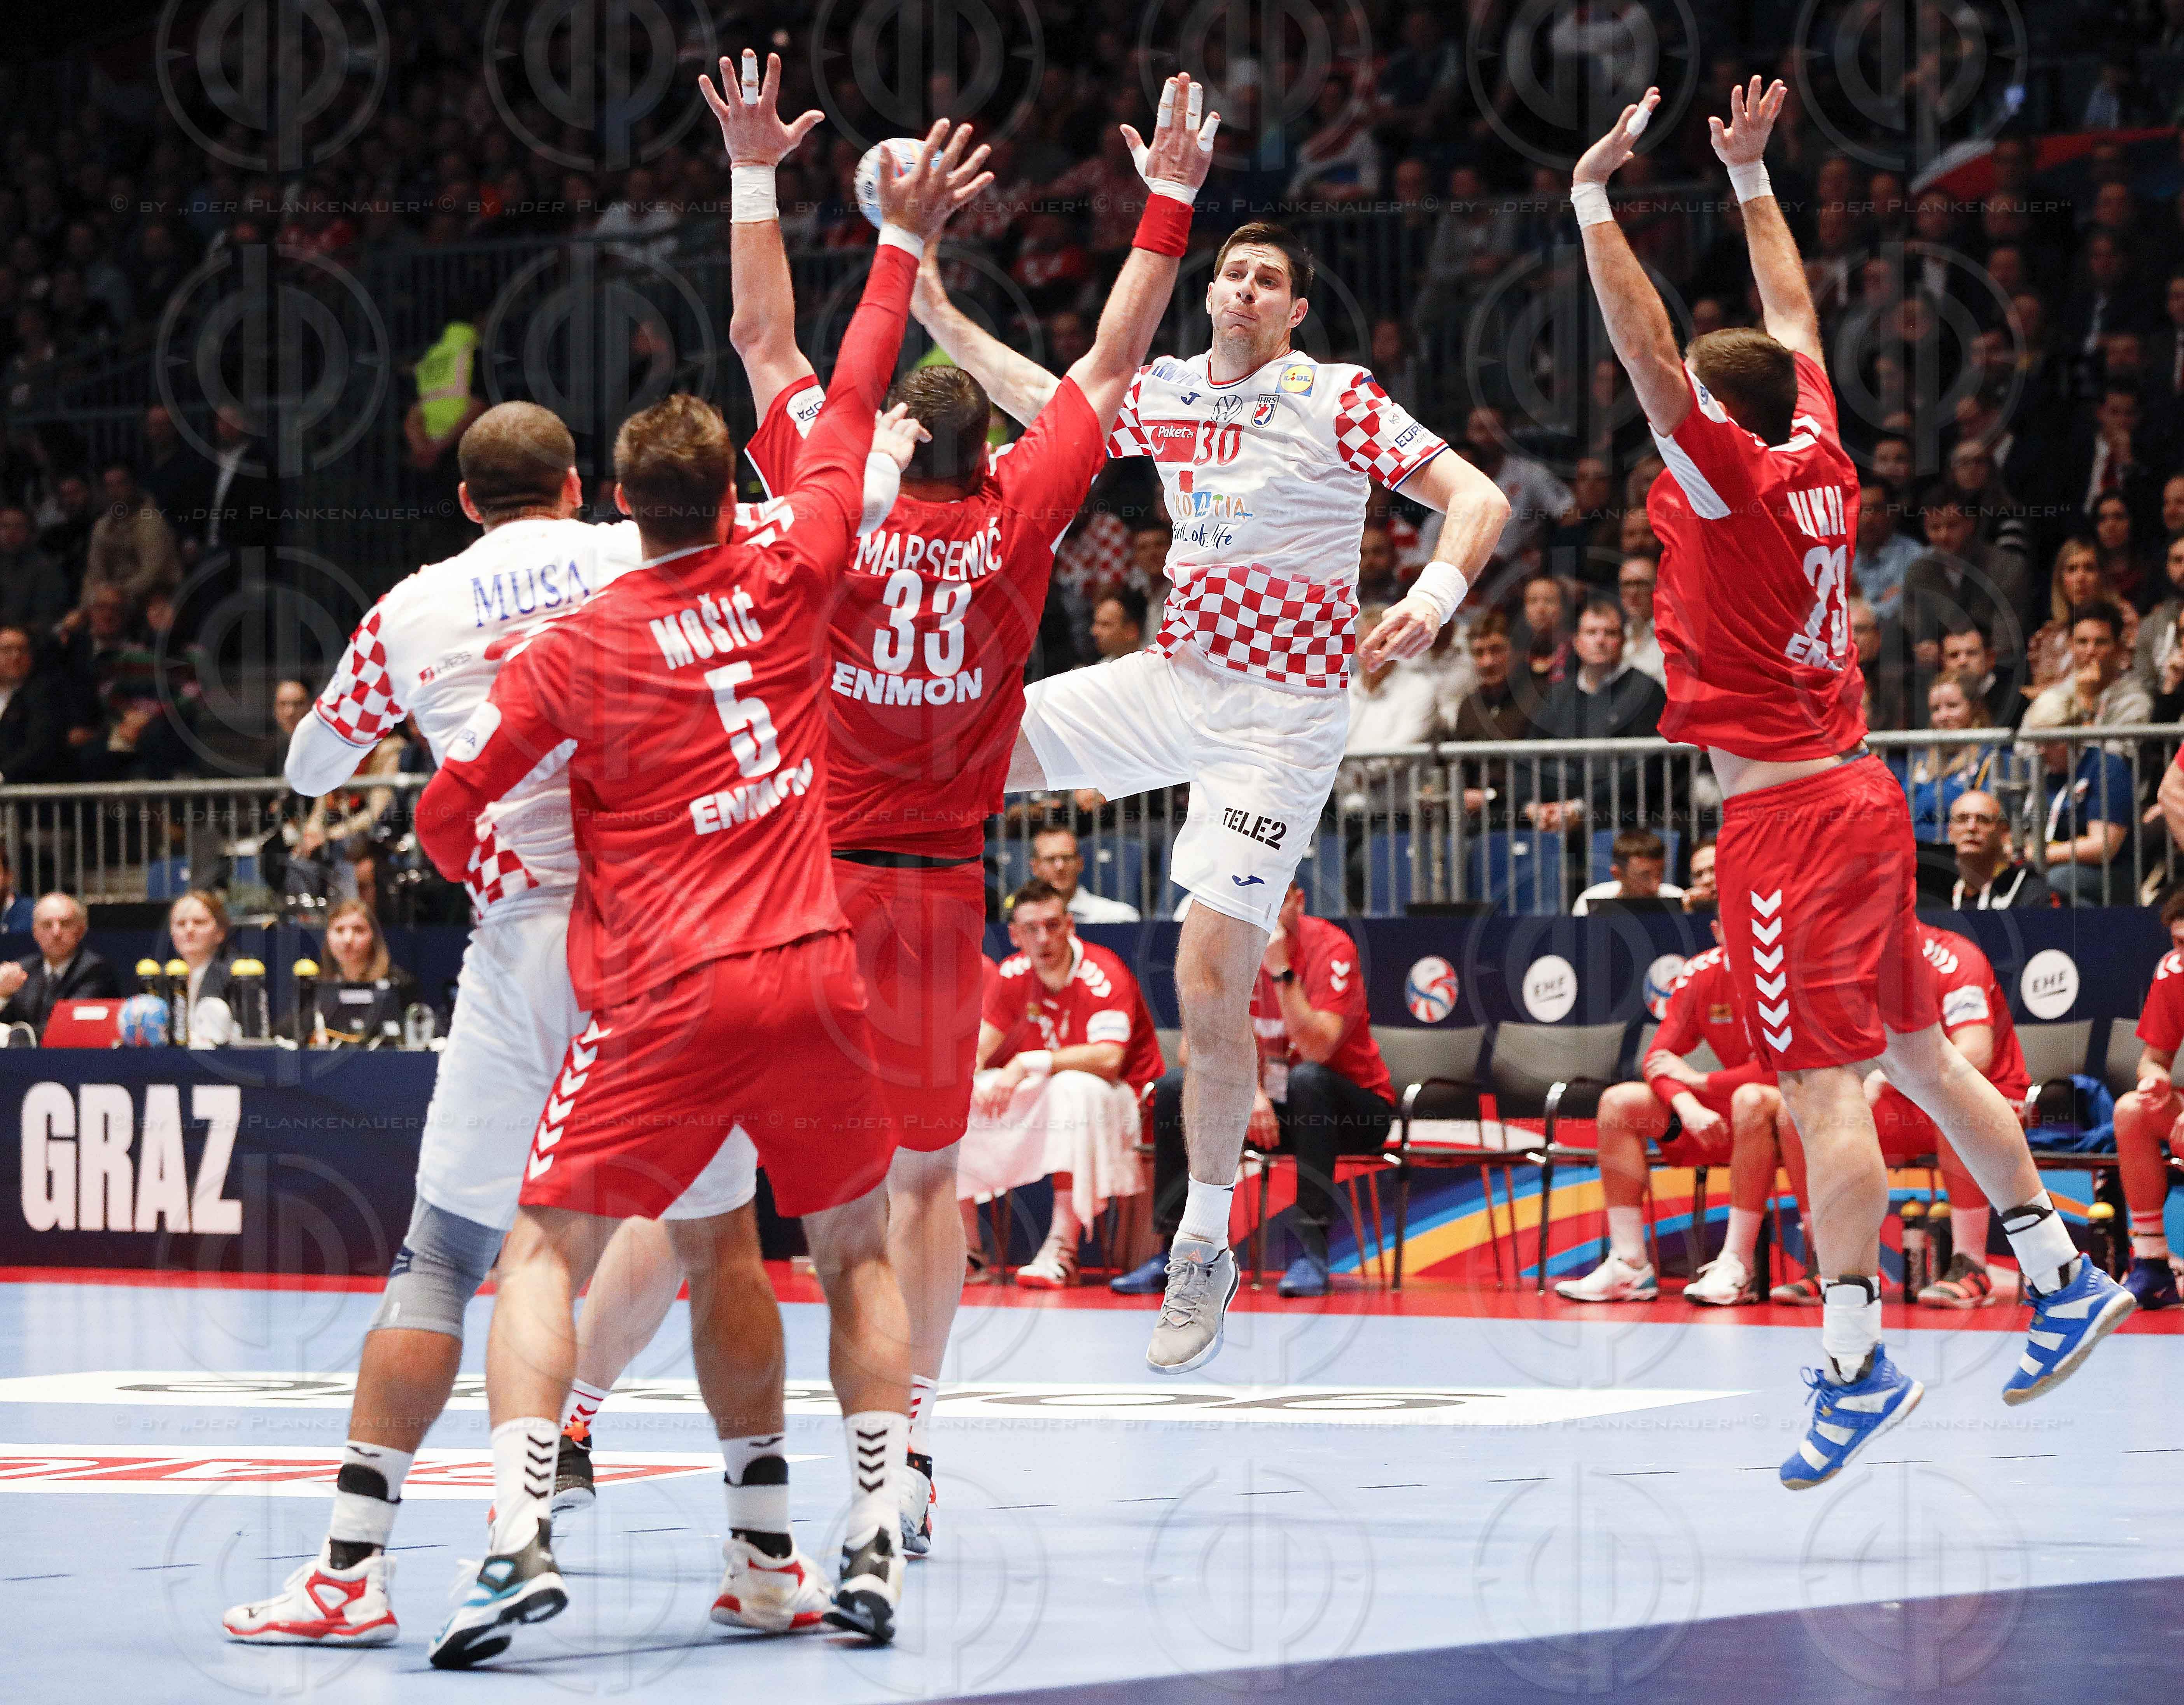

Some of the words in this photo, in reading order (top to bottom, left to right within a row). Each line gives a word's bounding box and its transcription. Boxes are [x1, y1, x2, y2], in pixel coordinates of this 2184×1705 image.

[1193, 420, 1244, 466] 30
[853, 517, 1002, 581] MARSENIĆ
[470, 560, 590, 627] MUSA
[873, 569, 973, 677] 33
[649, 585, 763, 670] MOŠIĆ
[831, 660, 983, 707] ENMON
[704, 660, 782, 778] 5
[1223, 807, 1287, 851] TELE2
[21, 1081, 243, 1235] GRAZ
